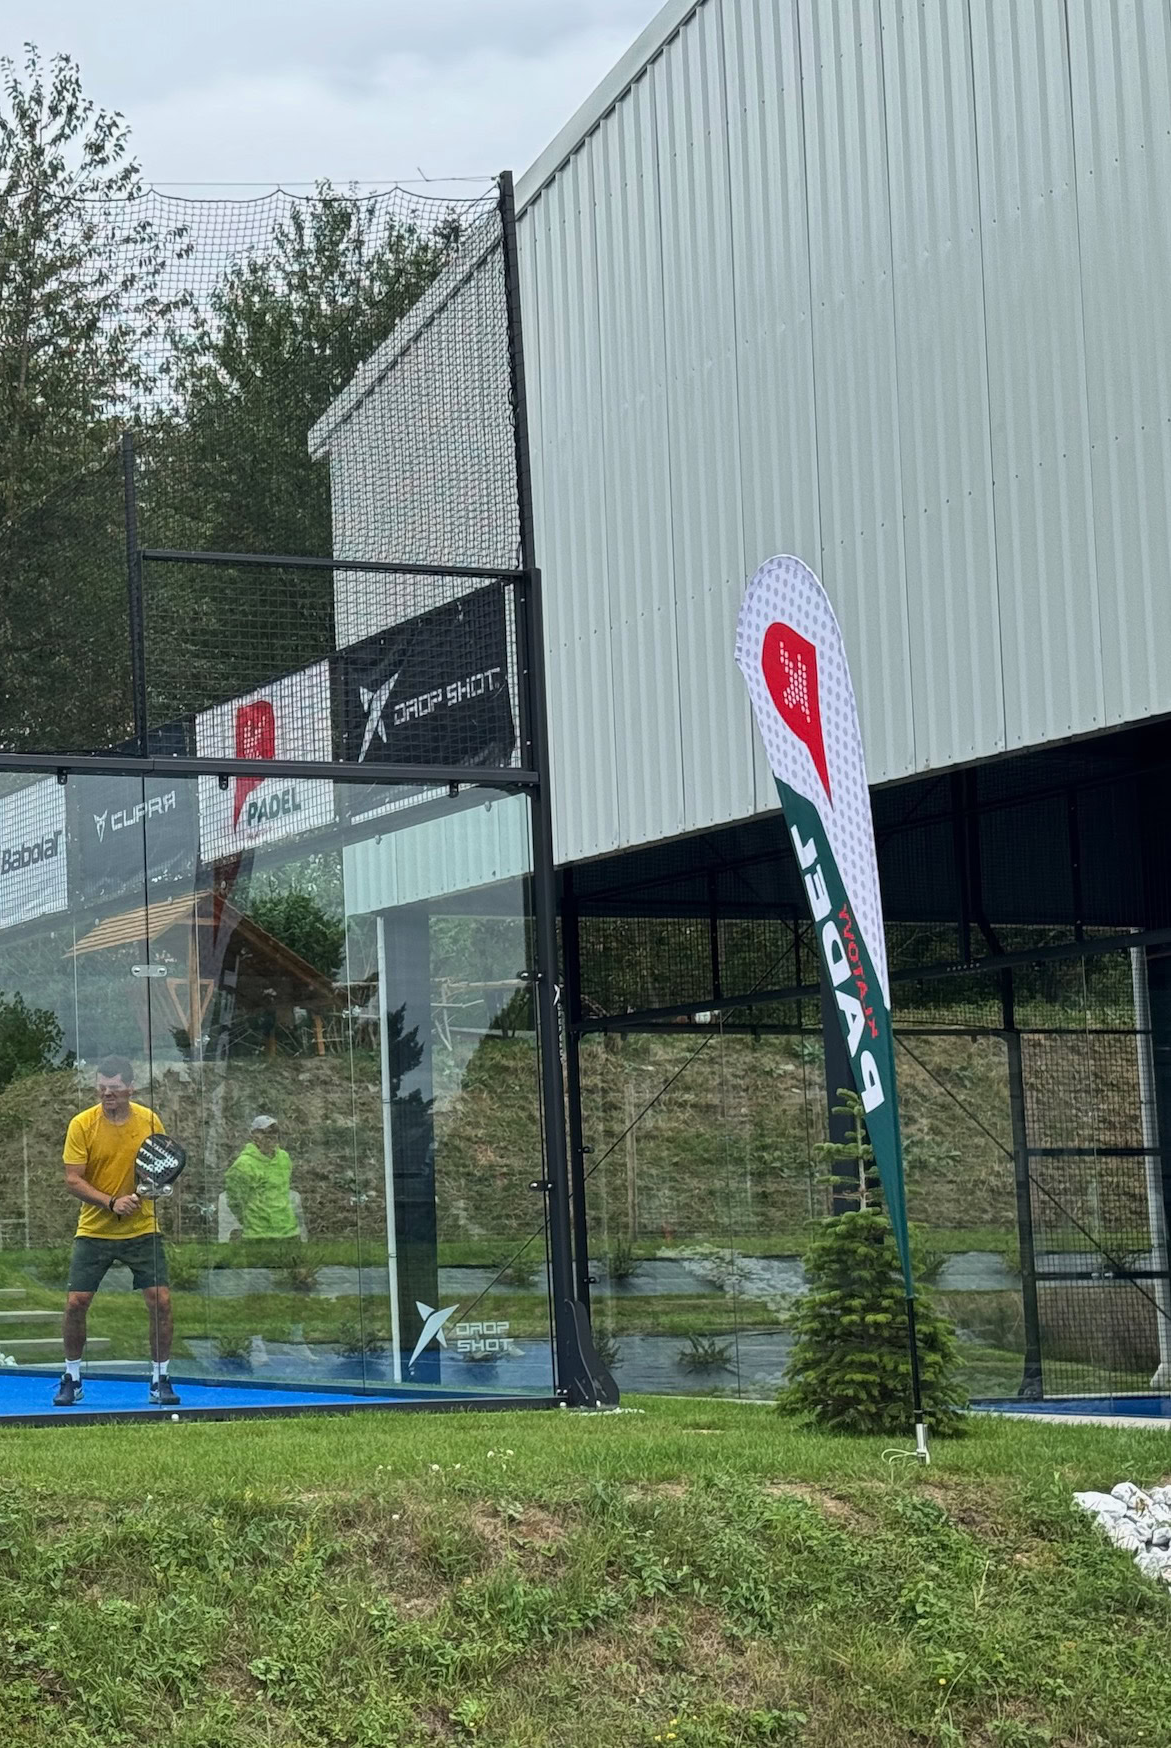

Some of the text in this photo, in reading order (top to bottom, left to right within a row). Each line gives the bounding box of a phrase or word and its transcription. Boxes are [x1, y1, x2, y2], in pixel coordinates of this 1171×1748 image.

[393, 667, 501, 726] DROP SHOT
[111, 790, 176, 832] CUPRA
[247, 786, 302, 827] PADEL
[455, 1321, 510, 1335] DROP
[456, 1338, 515, 1352] SHOT
